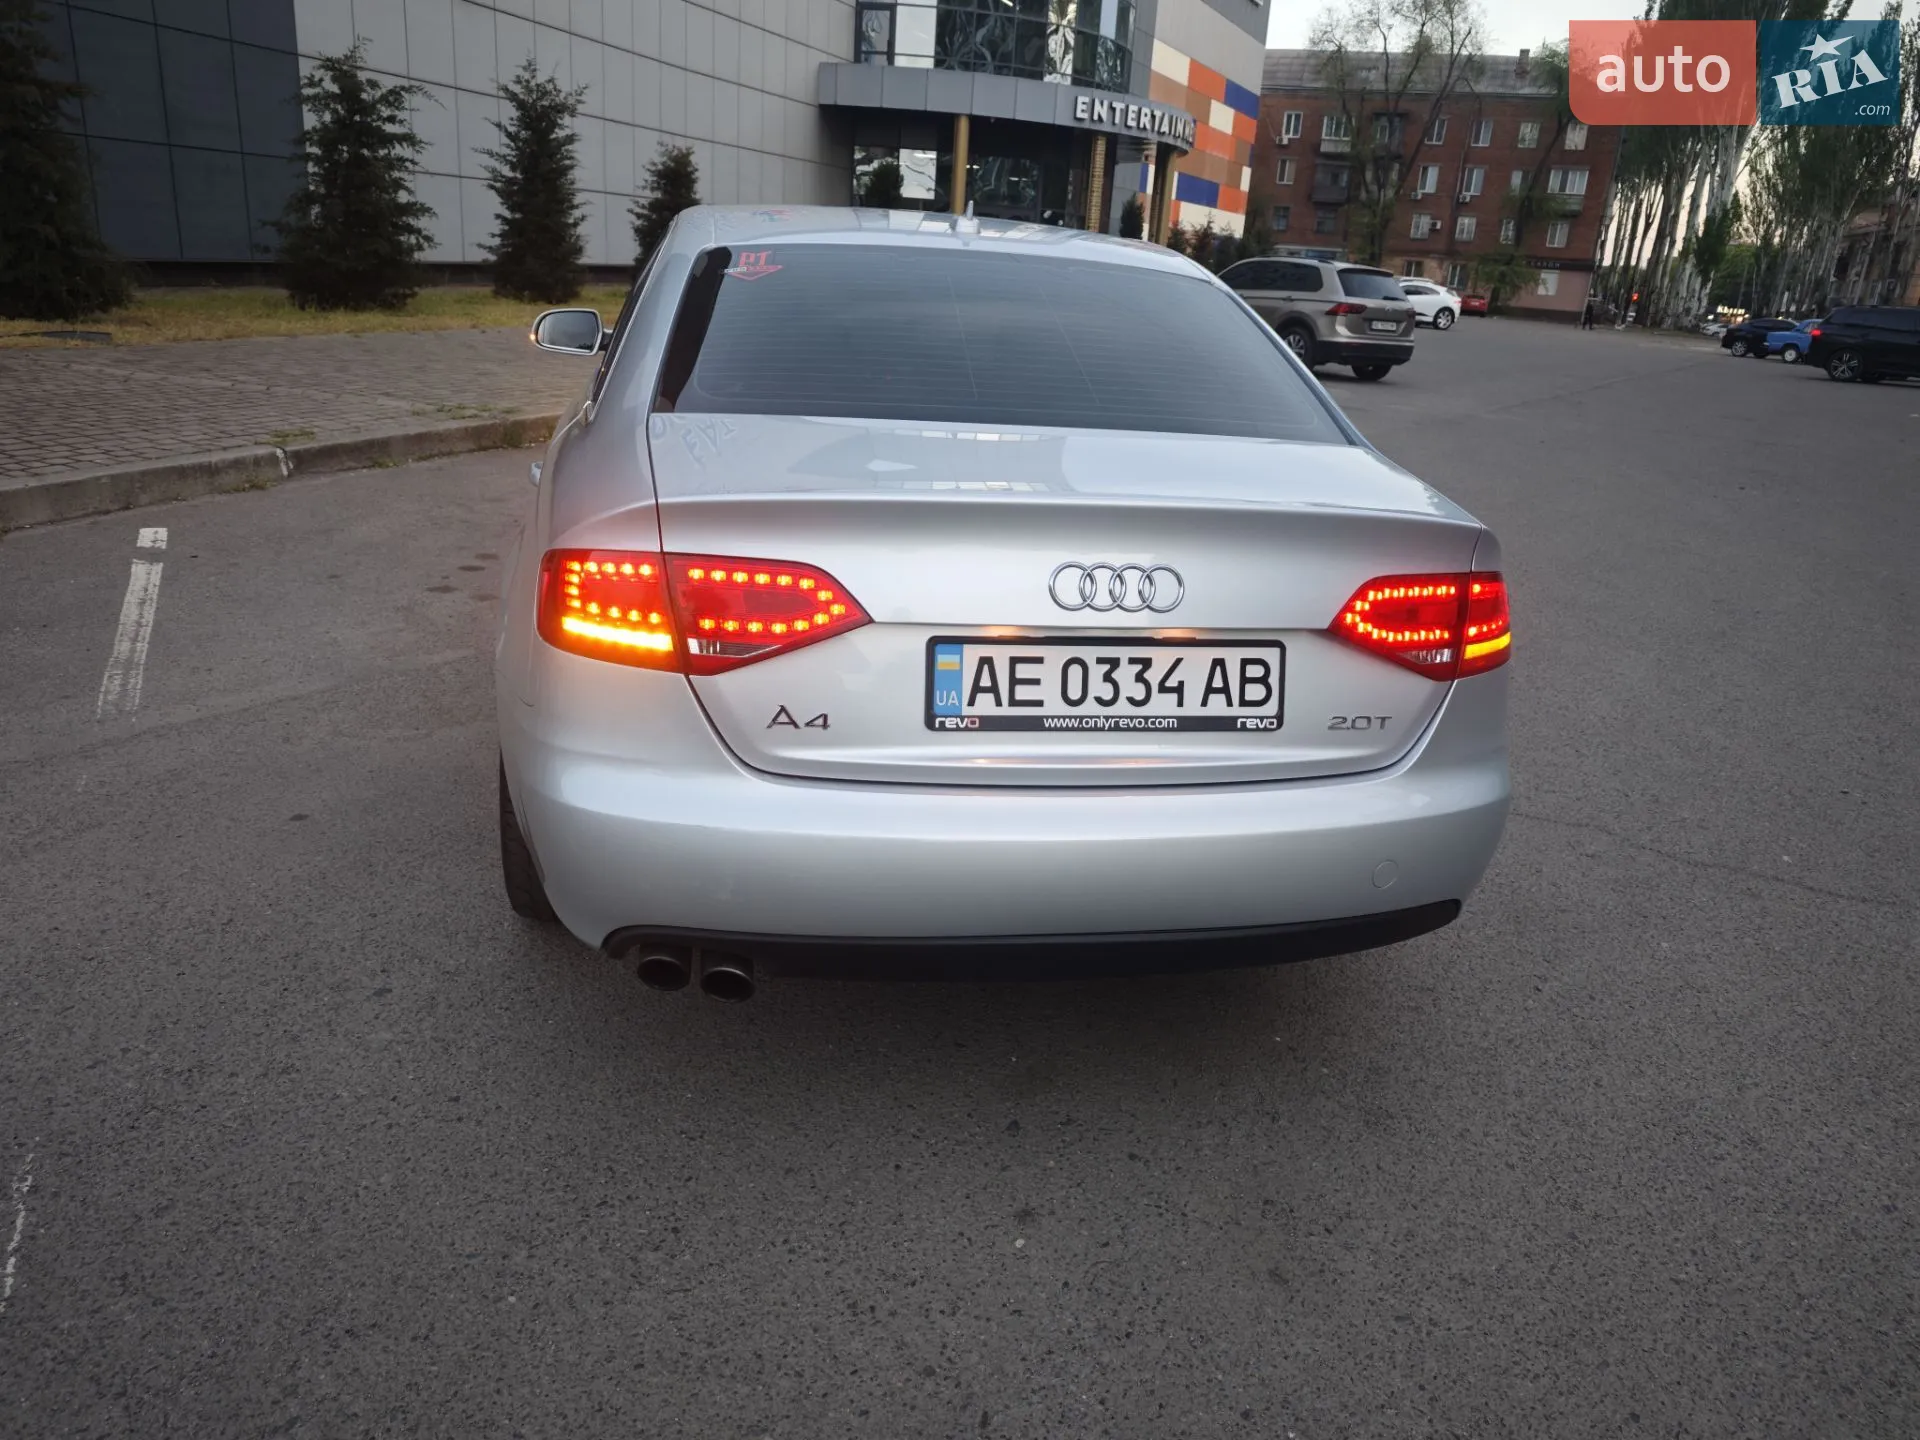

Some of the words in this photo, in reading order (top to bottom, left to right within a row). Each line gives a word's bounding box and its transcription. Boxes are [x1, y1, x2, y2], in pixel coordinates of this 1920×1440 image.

[967, 656, 1045, 708] AE
[1060, 656, 1185, 708] 0334
[1200, 657, 1273, 708] AB
[936, 690, 959, 706] UA
[766, 704, 831, 730] A4
[935, 717, 980, 729] revo
[1043, 715, 1178, 730] www.onlyrevo.com
[1237, 717, 1278, 729] revo
[1327, 715, 1393, 731] 2.0T
